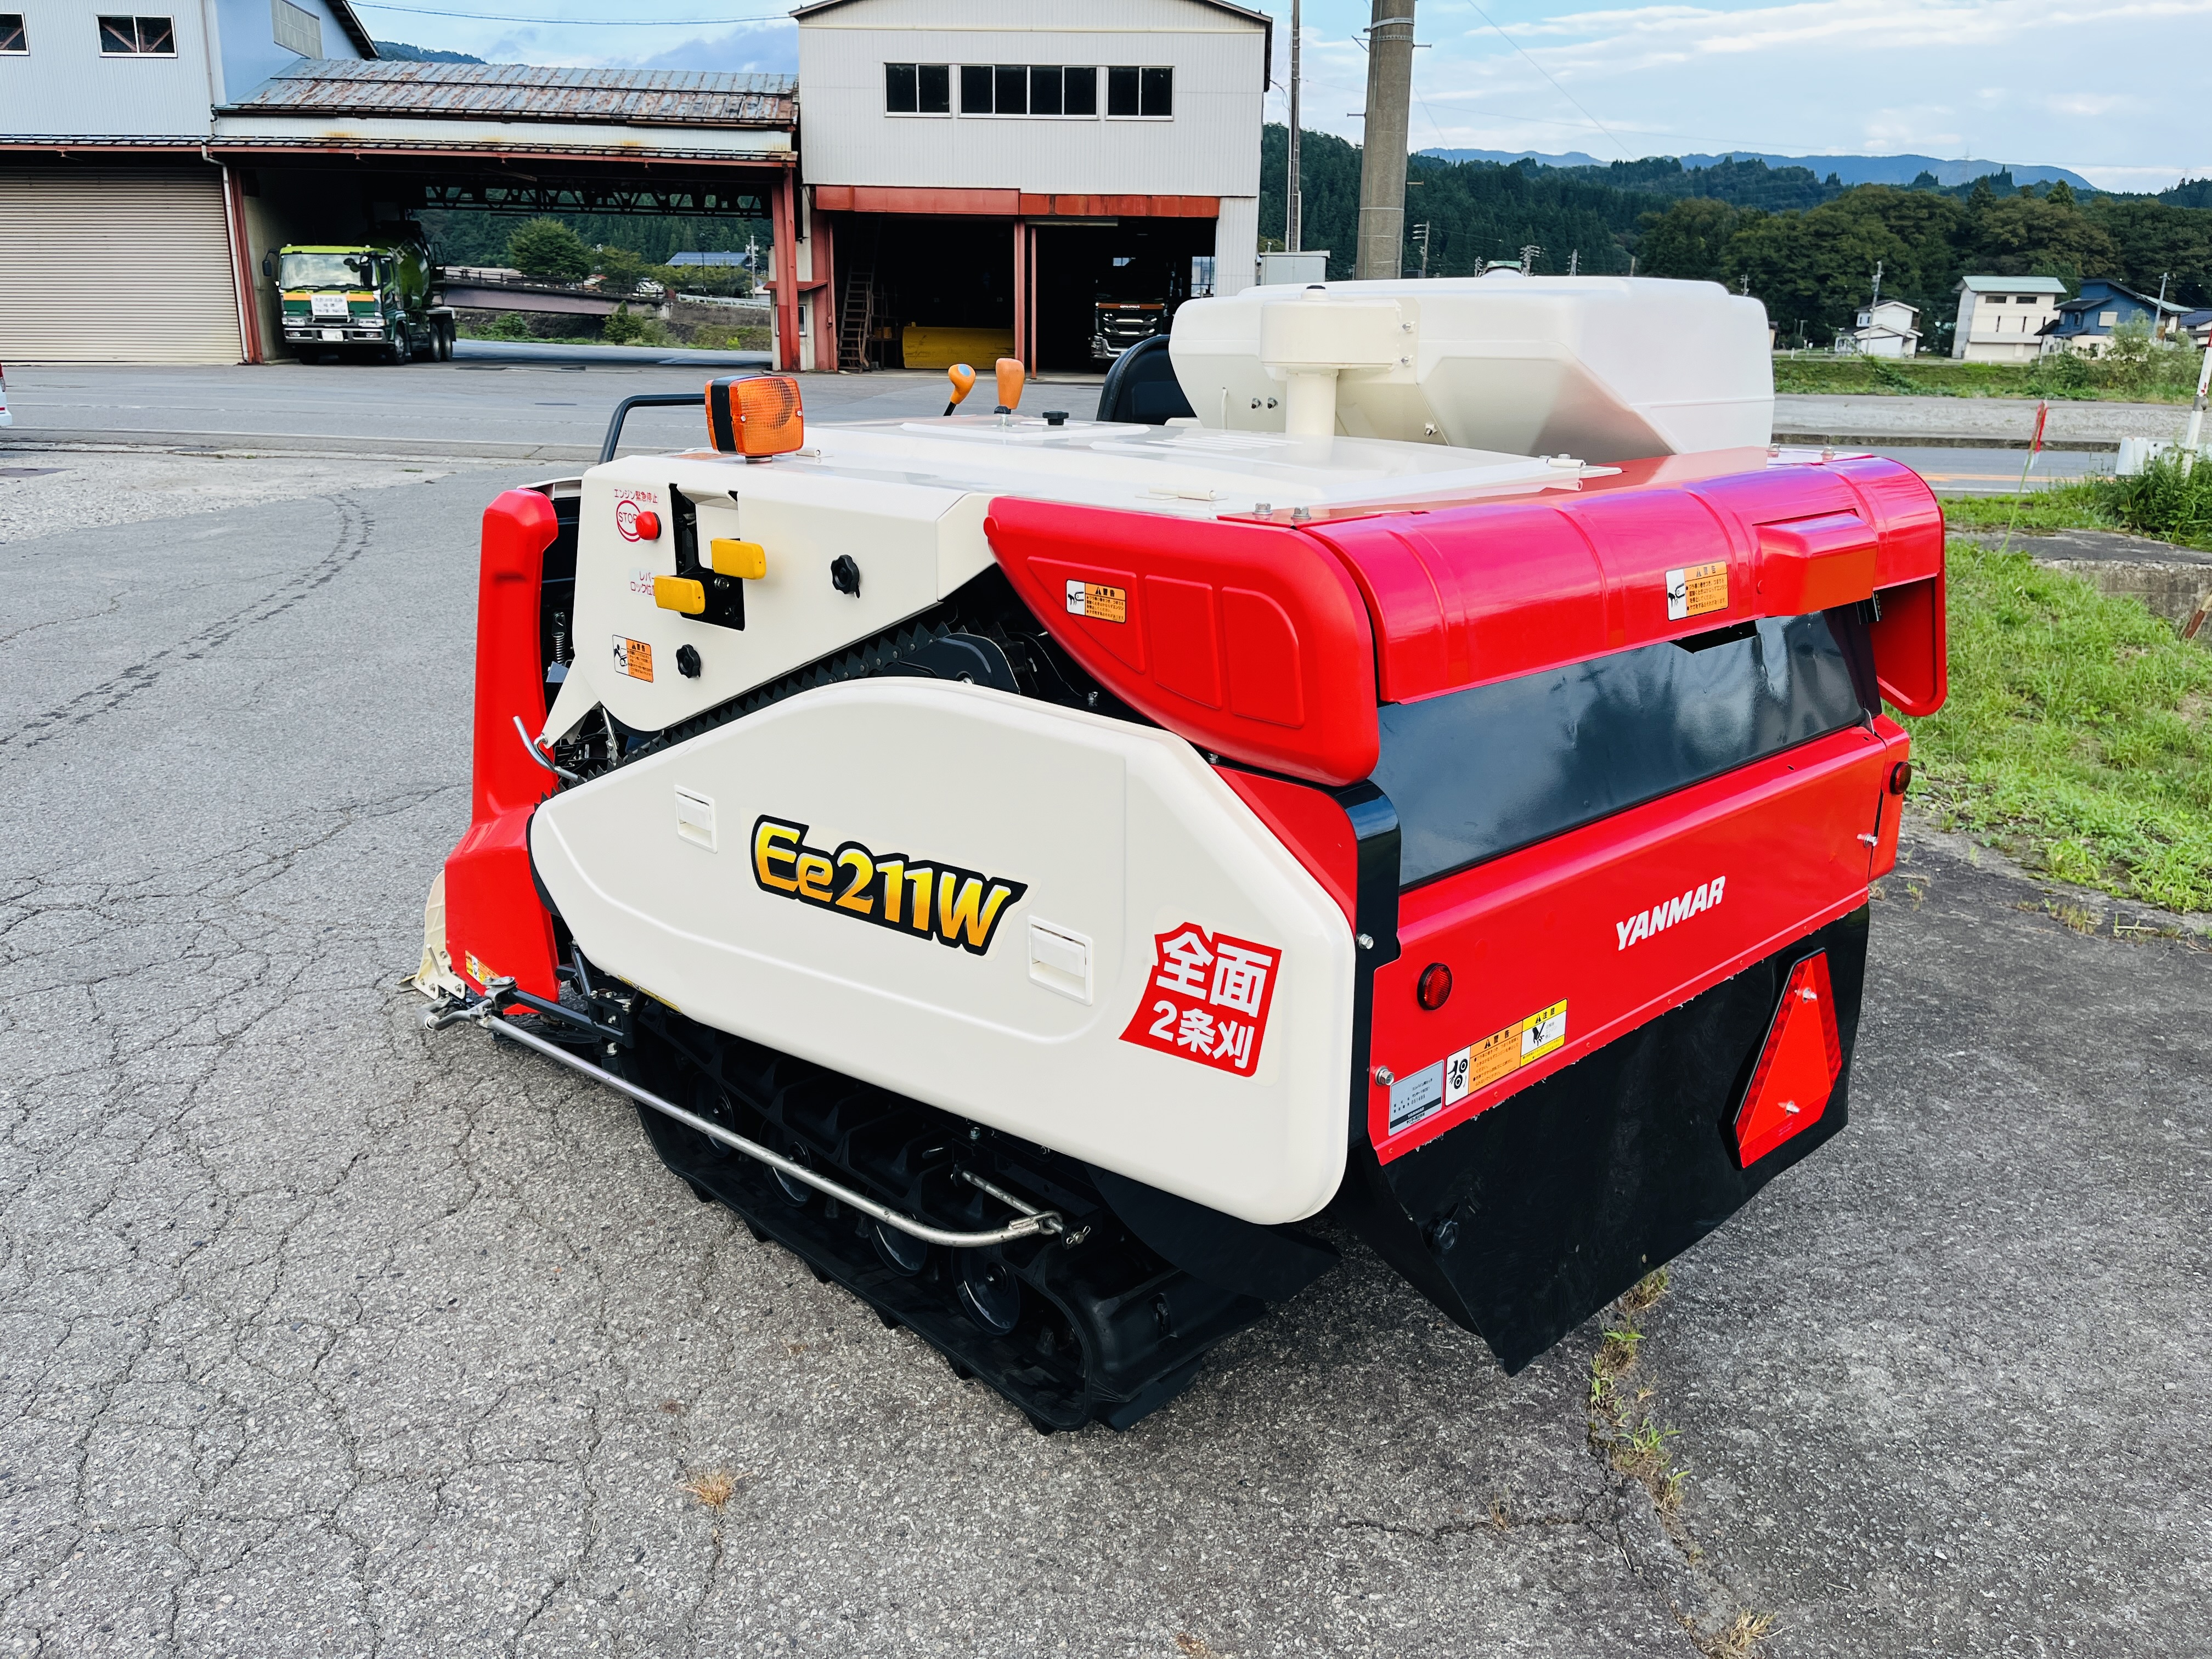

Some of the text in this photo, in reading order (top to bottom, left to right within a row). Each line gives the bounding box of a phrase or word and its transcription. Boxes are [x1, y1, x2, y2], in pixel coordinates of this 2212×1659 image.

[614, 489, 658, 504] エンジン緊急停止
[618, 511, 637, 524] STOP
[753, 819, 1013, 948] Ee211W
[1616, 875, 1726, 951] YANMAR
[1155, 930, 1273, 1019] 全面
[1148, 1000, 1255, 1069] 2条刈
